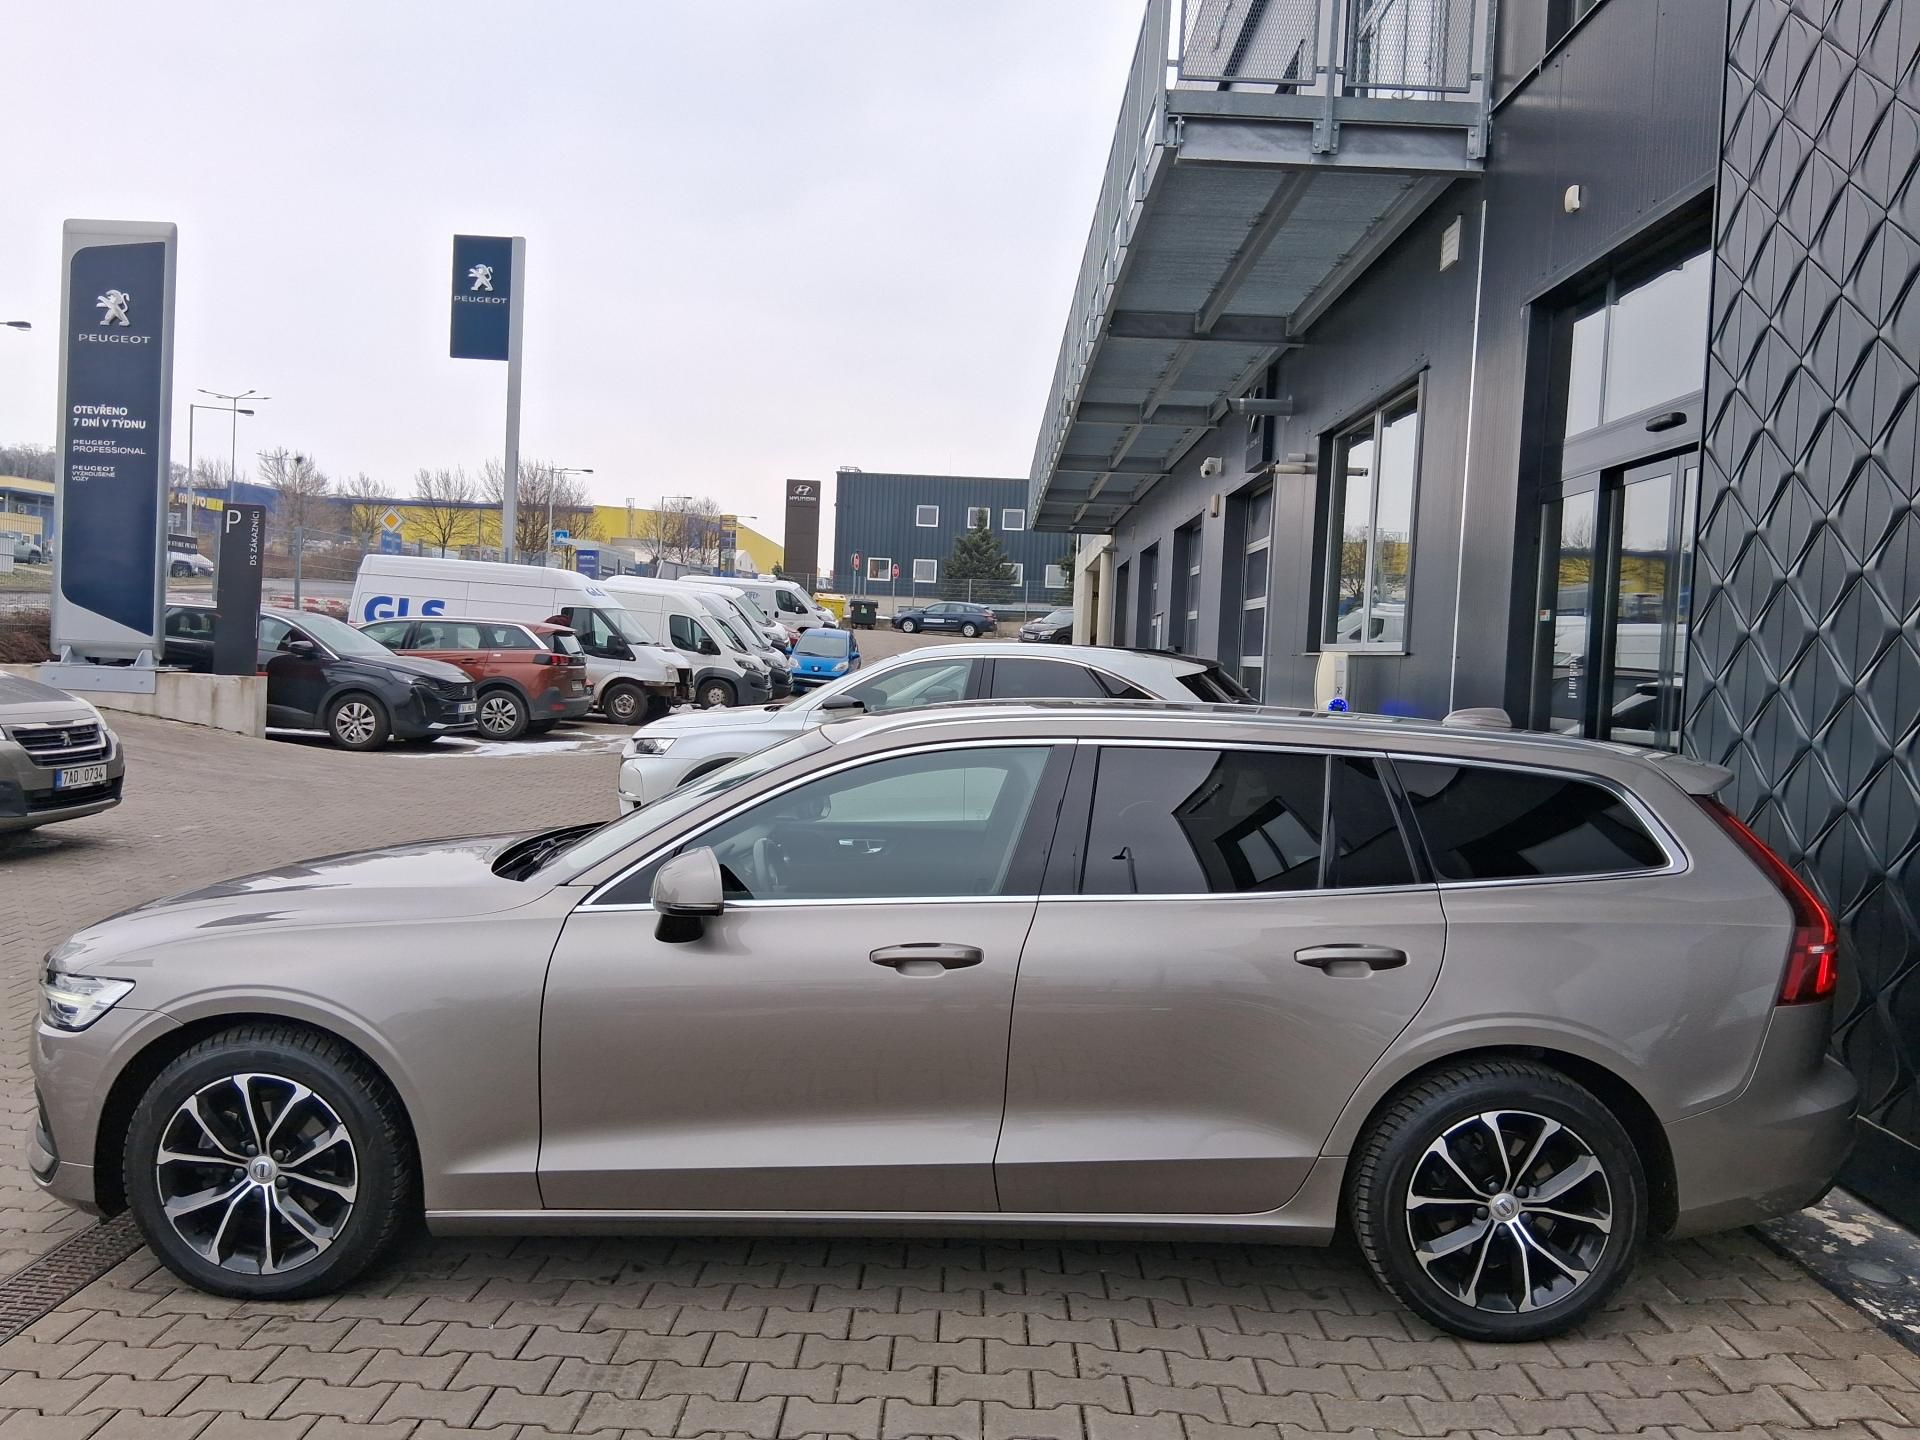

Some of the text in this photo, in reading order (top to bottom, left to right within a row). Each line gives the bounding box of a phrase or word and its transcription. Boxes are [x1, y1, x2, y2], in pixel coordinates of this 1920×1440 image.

[455, 295, 507, 304] PEUGEOT
[78, 333, 151, 344] PEUGEOT
[73, 404, 128, 416] OTEVŘENO
[73, 417, 146, 429] 7 DNÍ V TÝDNU
[73, 445, 146, 455] PROFESSIONAL
[225, 509, 242, 533] P
[249, 511, 260, 566] DS ZÁKAZNÍCI
[63, 767, 104, 786] 7AD 0734
